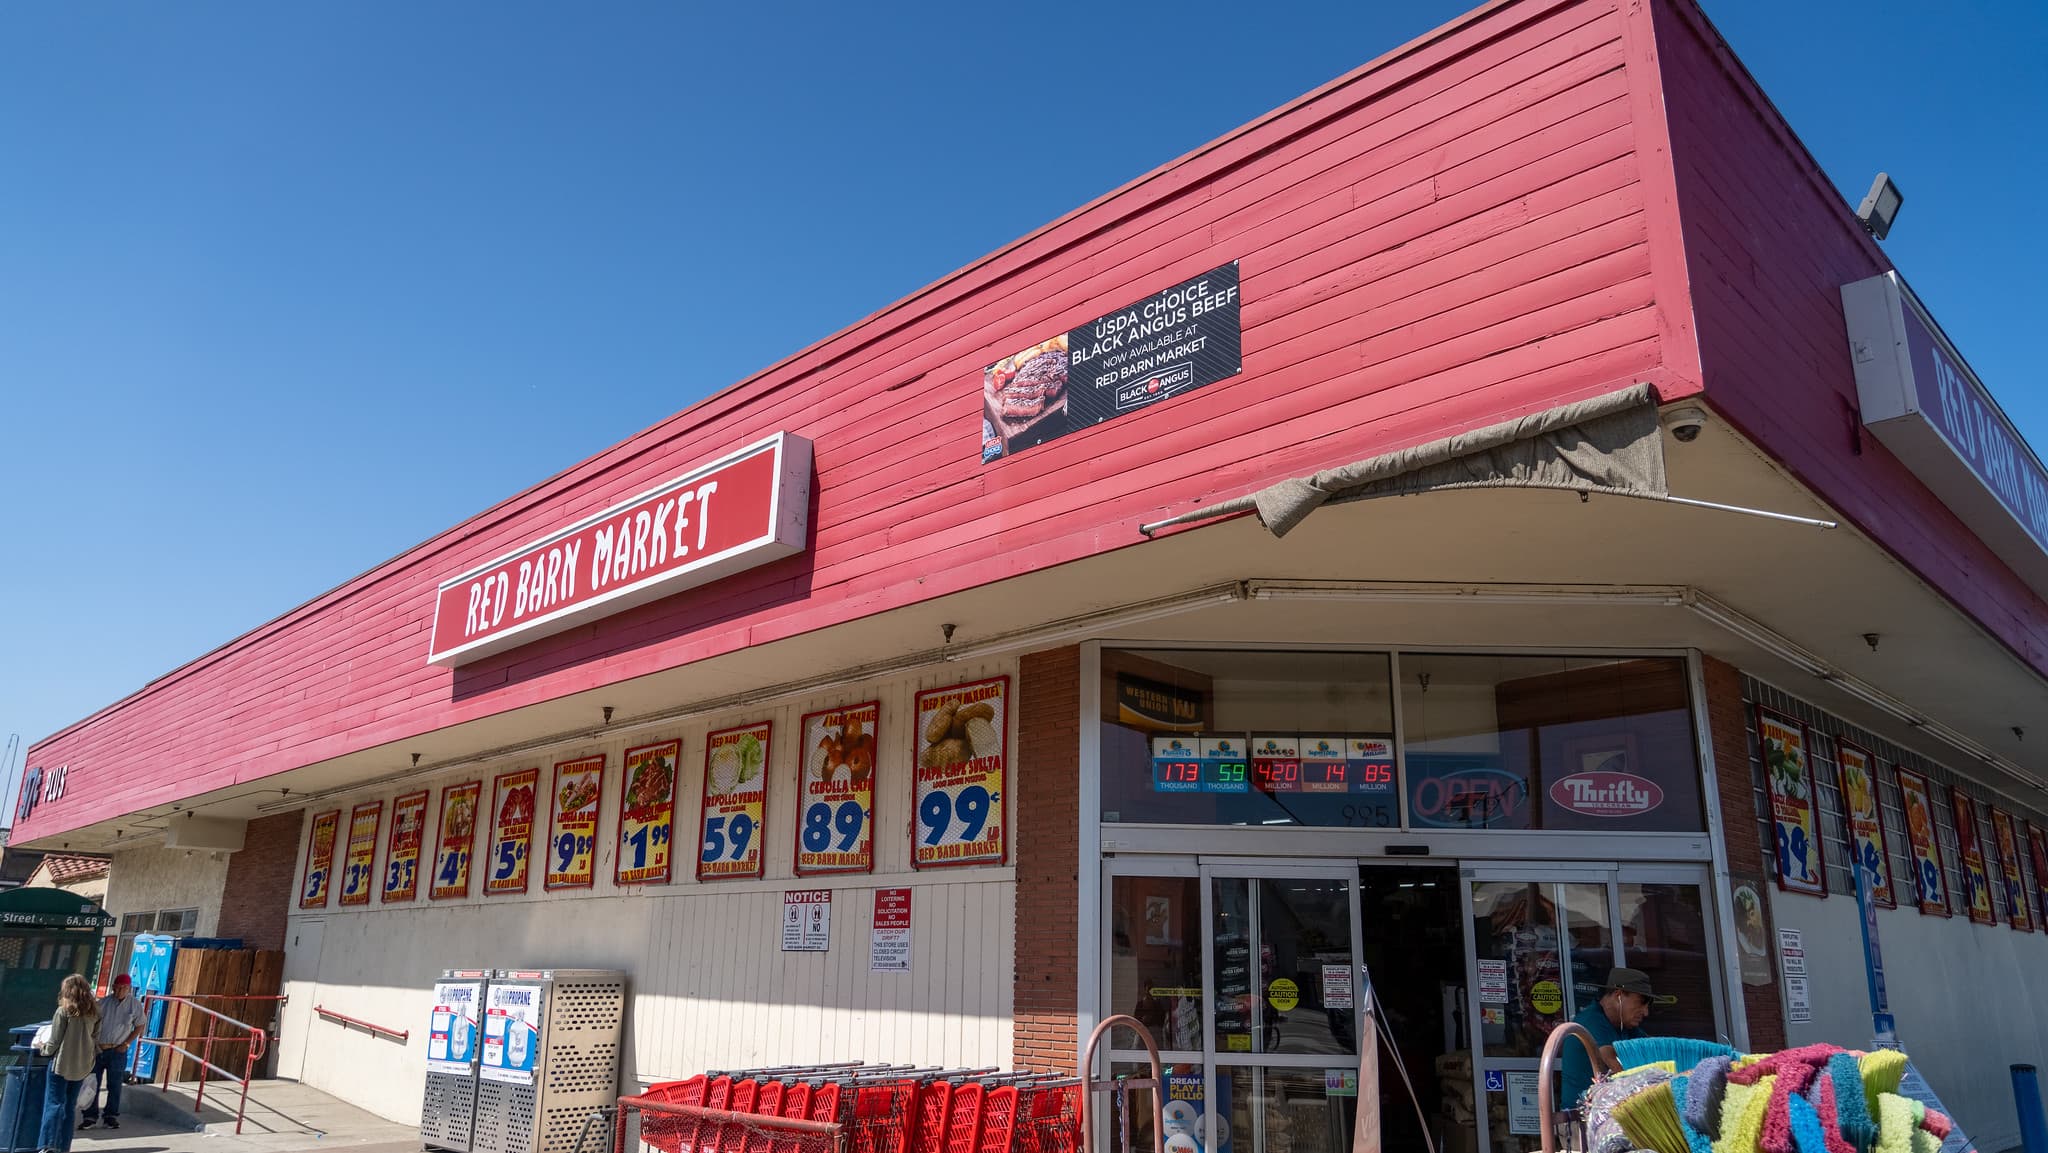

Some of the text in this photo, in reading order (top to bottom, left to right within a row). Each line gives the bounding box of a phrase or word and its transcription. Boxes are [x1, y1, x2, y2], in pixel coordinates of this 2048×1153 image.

[1096, 280, 1209, 339] USDA CHOICE
[1072, 286, 1237, 365] BLACK ANGUS BEEF
[1103, 324, 1198, 369] NOW AVAILABLE AT
[1096, 336, 1207, 388] RED BARN MARKET
[1120, 385, 1147, 400] BLACK
[1159, 370, 1189, 387] ANGUS
[1932, 347, 1976, 460] RED
[1974, 399, 2024, 515] BARN
[465, 481, 718, 637] RED BARN MARKET
[922, 697, 938, 712] RED
[964, 684, 1000, 705] MARKET
[1126, 687, 1168, 704] WESTERN
[1140, 700, 1168, 713] UNION
[1166, 764, 1198, 781] 173
[1219, 764, 1245, 781] 59
[1259, 764, 1297, 781] 420
[1326, 765, 1345, 780] 14
[1365, 765, 1391, 782] 85
[43, 764, 69, 803] PLUS
[809, 780, 849, 794] CEBOLLA
[1415, 777, 1518, 817] OPEN
[1563, 779, 1649, 808] Thrifty
[1342, 805, 1390, 826] 995
[987, 826, 999, 841] LB
[655, 853, 663, 864] LB
[748, 849, 757, 861] LB
[801, 853, 869, 865] RED BARN MARKET
[919, 841, 999, 861] RED BARN MARKET
[580, 860, 586, 870] LB
[732, 861, 756, 872] MARKET
[785, 891, 829, 903] NOTICE
[3, 913, 113, 927] Street 6A, 6B, 16
[812, 923, 820, 932] NO
